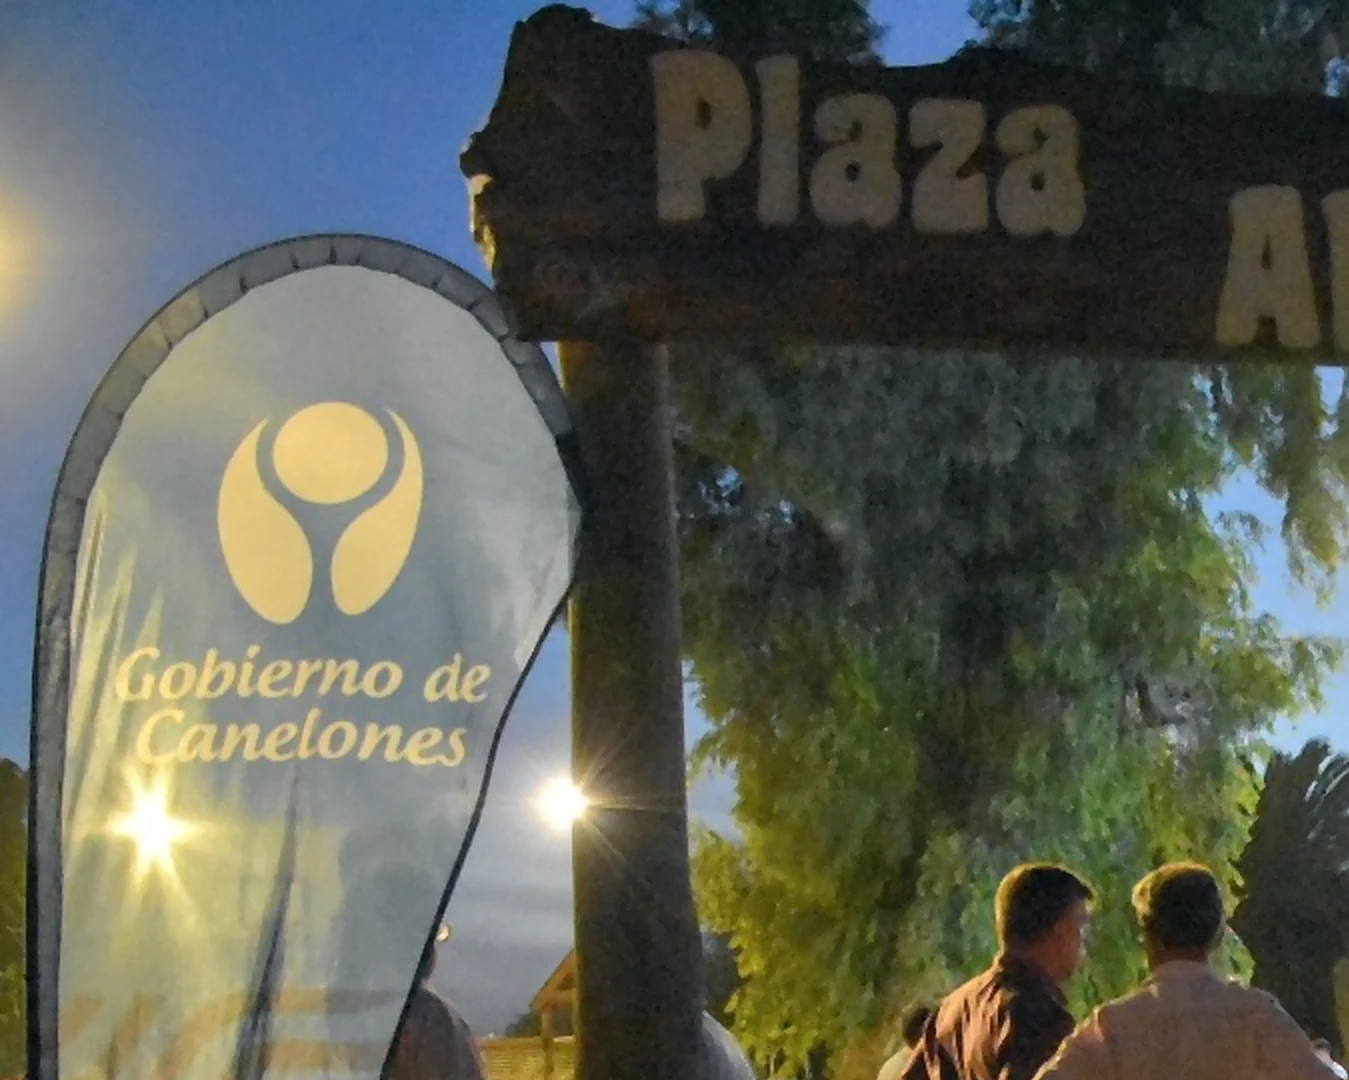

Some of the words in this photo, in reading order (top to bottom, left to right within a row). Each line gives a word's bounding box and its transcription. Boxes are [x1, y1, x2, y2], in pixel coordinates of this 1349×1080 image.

[652, 49, 1087, 237] Plaza
[115, 645, 403, 701] Gobierno
[423, 653, 491, 704] de
[135, 708, 467, 768] Canelones
